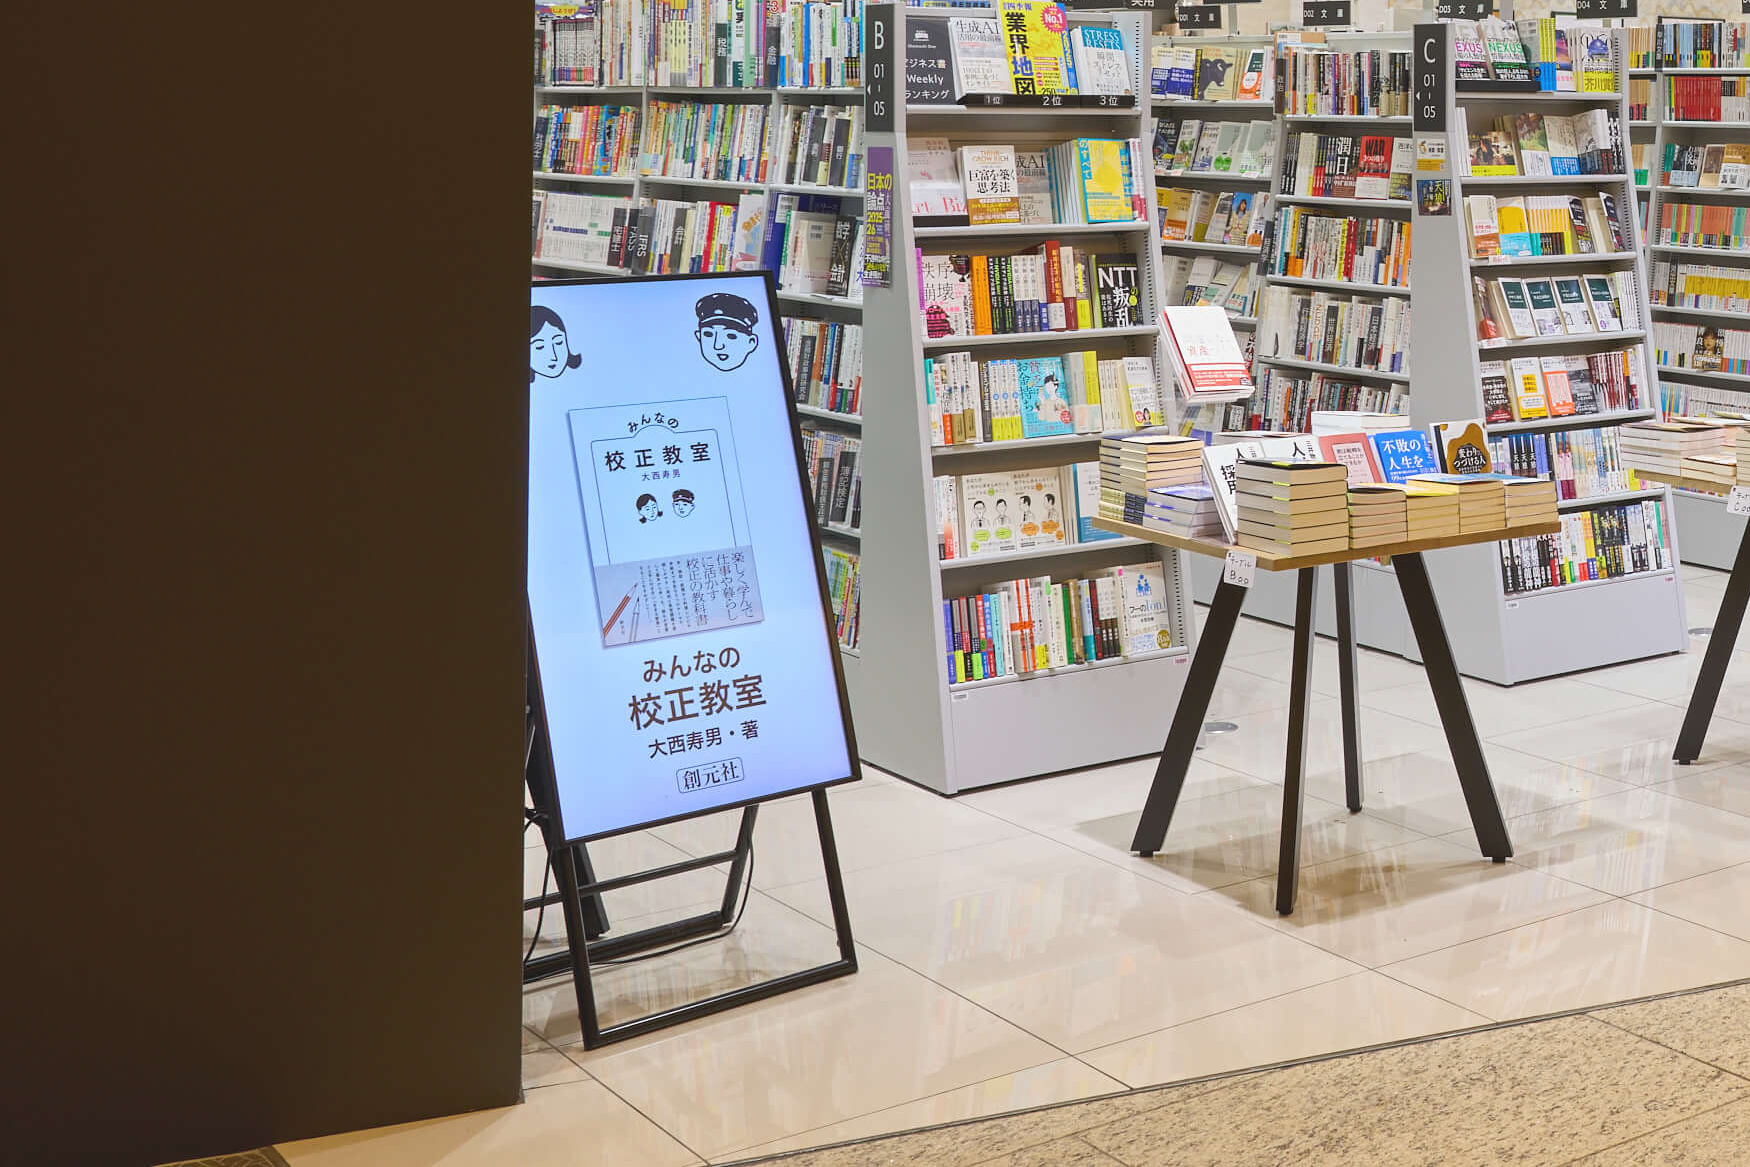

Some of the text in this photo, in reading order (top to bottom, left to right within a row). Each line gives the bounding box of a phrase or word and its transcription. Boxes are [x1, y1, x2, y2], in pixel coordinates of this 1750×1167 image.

[1599, 0, 1628, 10] 文庫
[1044, 14, 1063, 24] No.1
[874, 21, 885, 50] B
[1084, 29, 1120, 41] STRESS
[1004, 11, 1035, 95] 業界地図
[1423, 39, 1436, 63] C
[1488, 42, 1523, 54] NEXUS
[873, 64, 885, 78] 01
[907, 73, 944, 86] Weekly
[1423, 74, 1436, 87] 01
[873, 101, 885, 116] 05
[1043, 96, 1061, 106] 2位
[1099, 96, 1118, 106] 3位
[1423, 105, 1436, 118] 05
[1365, 139, 1385, 156] WAR
[867, 173, 892, 190] 日本の
[977, 181, 1011, 194] 思考法
[637, 234, 649, 257] IFRS
[1098, 267, 1137, 288] NTT
[627, 411, 679, 433] みんなの
[1382, 439, 1421, 454] 不敗の
[604, 441, 711, 471] 校正教室
[1388, 455, 1424, 470] 人生を
[641, 468, 681, 482] 大西寿男
[702, 556, 716, 602] に活かす
[731, 552, 753, 618] 楽しく学んで
[642, 647, 740, 683] みんなの
[628, 674, 767, 731] 校正教室
[648, 720, 759, 759] 大西寿男・著
[683, 761, 740, 790] 創元社
